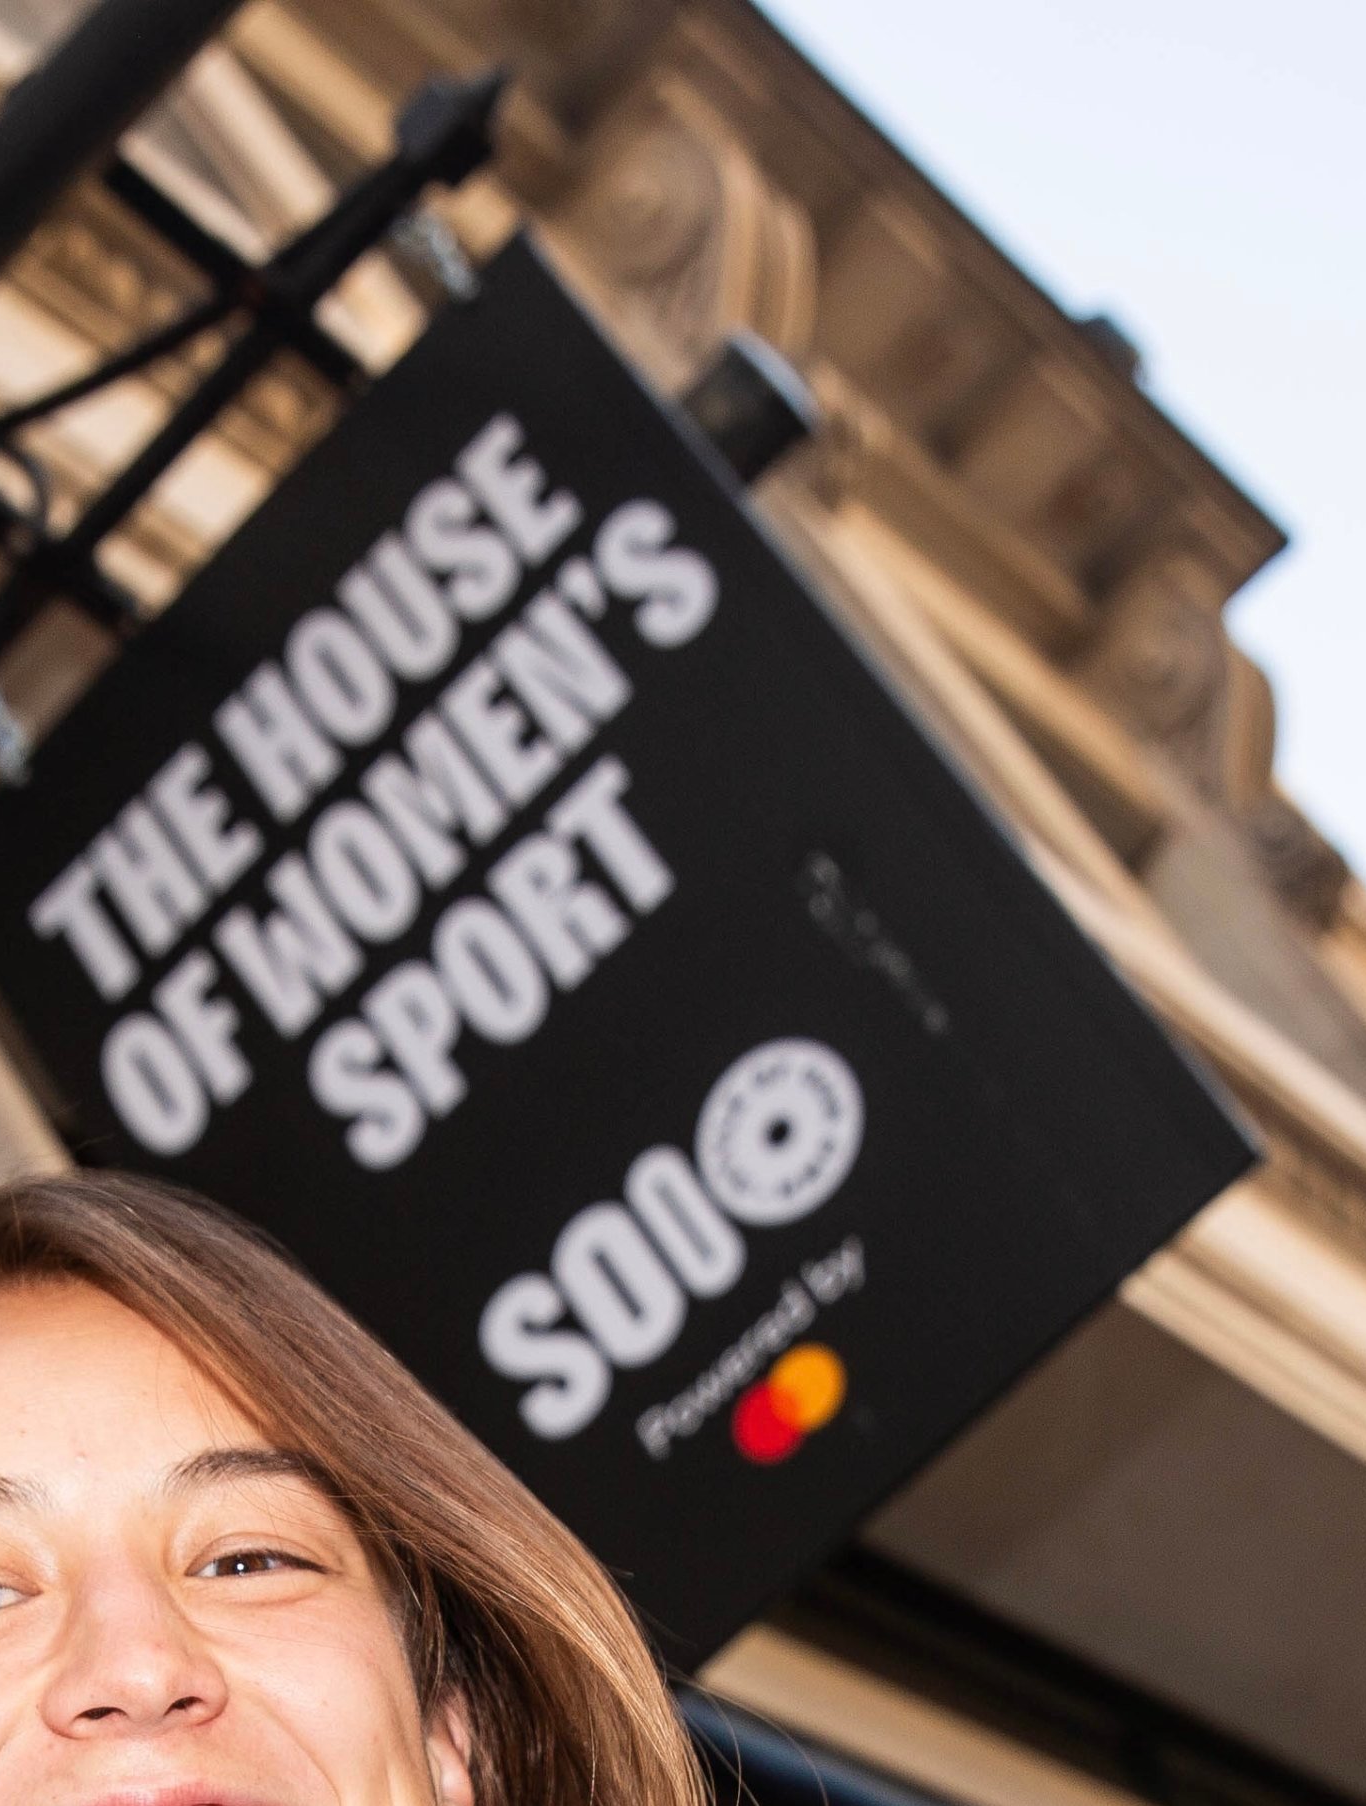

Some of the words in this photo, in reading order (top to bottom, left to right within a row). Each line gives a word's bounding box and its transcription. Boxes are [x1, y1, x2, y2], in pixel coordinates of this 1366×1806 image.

[31, 746, 262, 998] THE
[216, 415, 581, 821] HOUSE
[102, 952, 251, 1154] OF
[215, 500, 719, 1036] WOMEN'S
[308, 756, 674, 1169] SPORT
[636, 1279, 815, 1459] Powered
[801, 1236, 865, 1303] by
